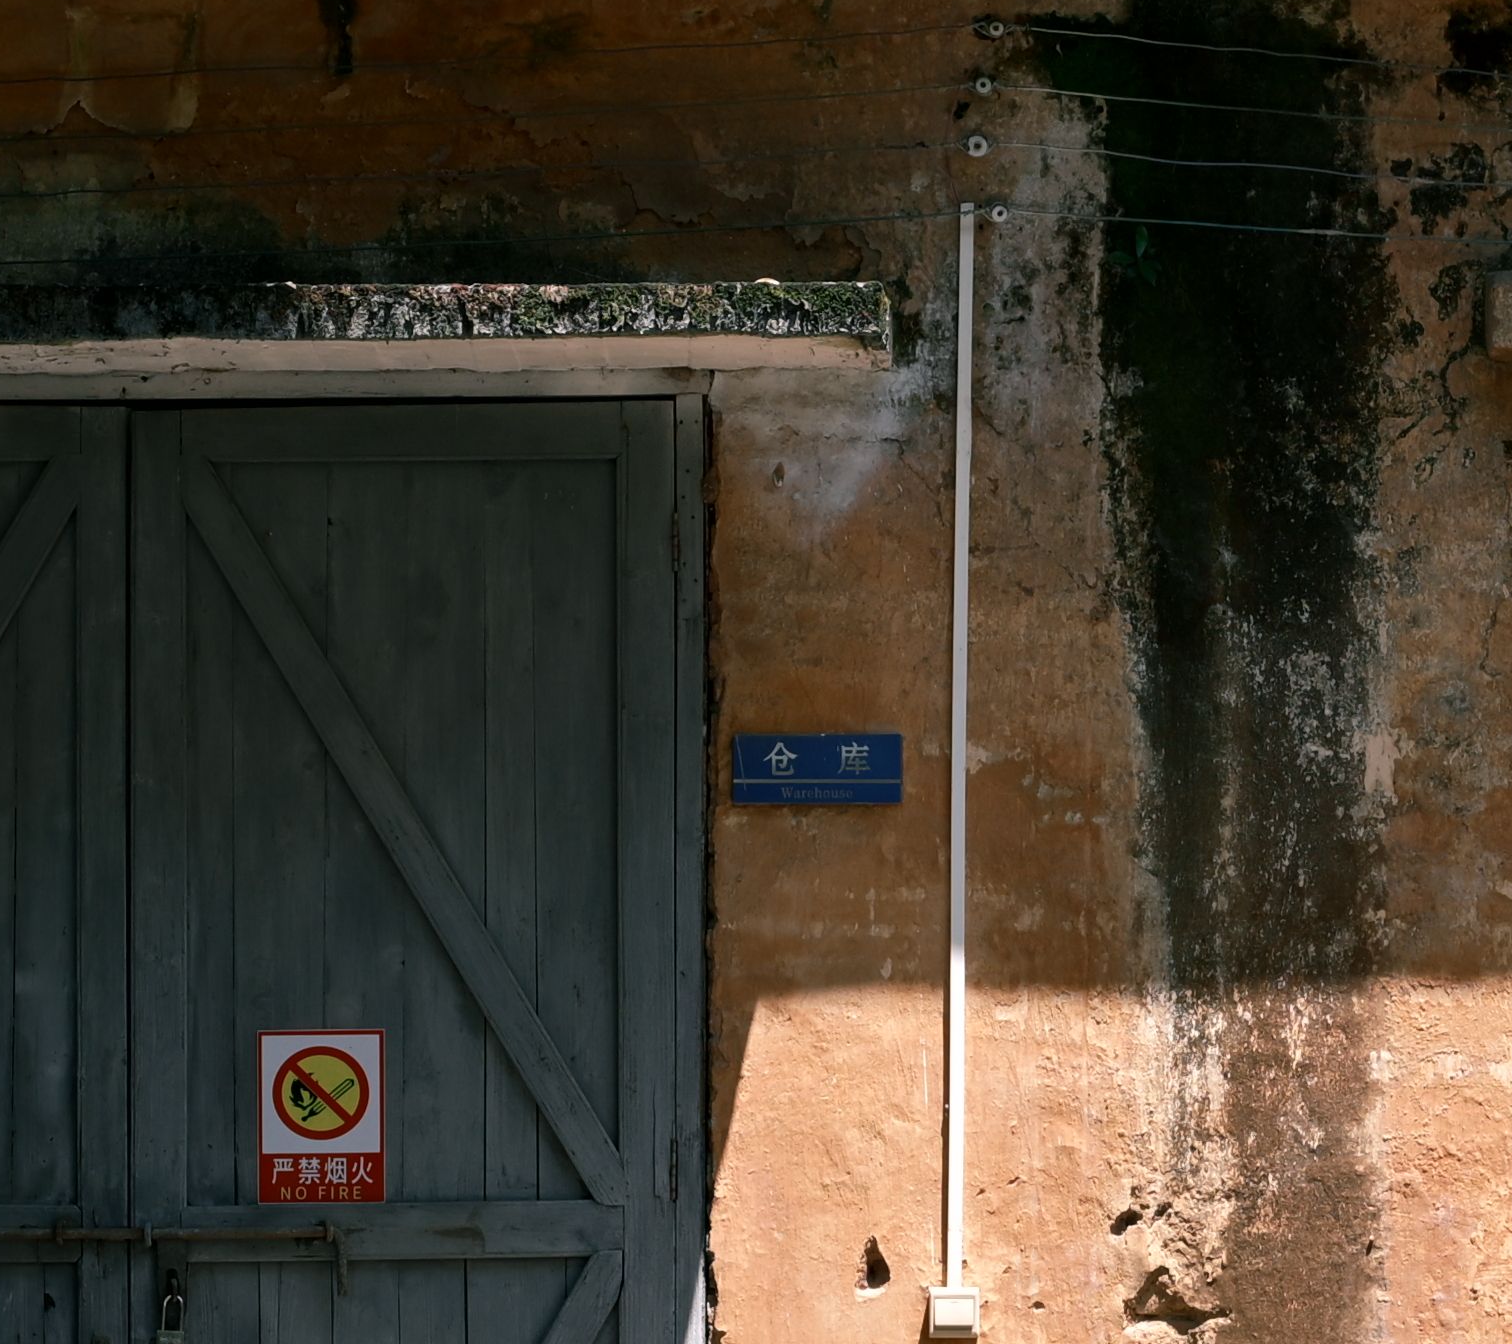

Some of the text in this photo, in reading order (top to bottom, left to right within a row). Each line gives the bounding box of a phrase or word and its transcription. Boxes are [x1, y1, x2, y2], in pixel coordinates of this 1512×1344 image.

[762, 741, 871, 776] 仓库
[780, 786, 854, 799] Warehouse
[271, 1156, 374, 1185] 严禁烟火
[280, 1185, 363, 1200] NO FIRE
